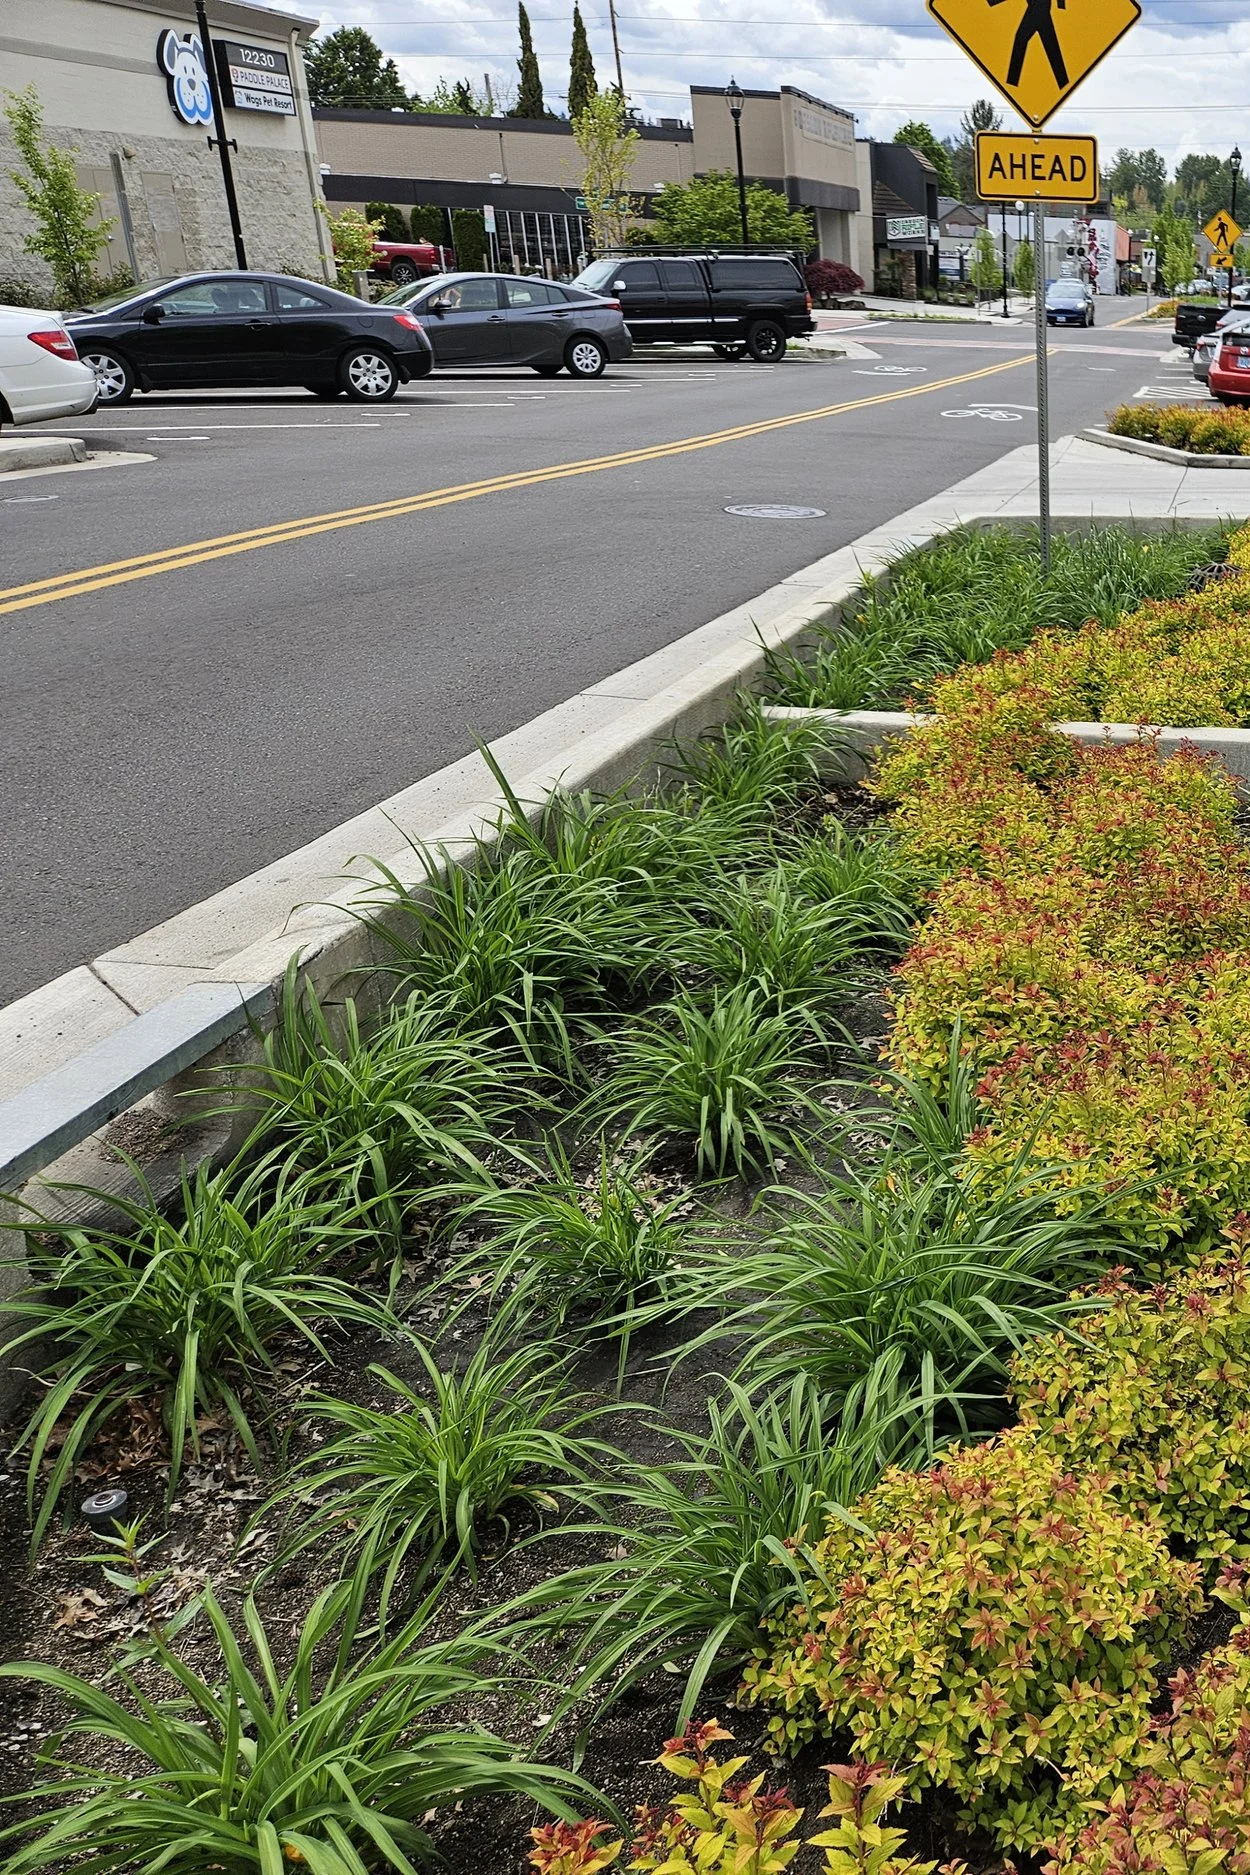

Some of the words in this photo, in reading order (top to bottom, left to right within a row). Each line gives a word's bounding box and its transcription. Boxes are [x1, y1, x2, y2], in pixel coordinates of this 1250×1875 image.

[239, 48, 275, 68] 12230
[240, 71, 265, 86] PADDLE
[266, 76, 289, 89] PALACE
[263, 95, 274, 107] Pet
[274, 97, 292, 110] Resort
[988, 152, 1087, 182] AHEAD
